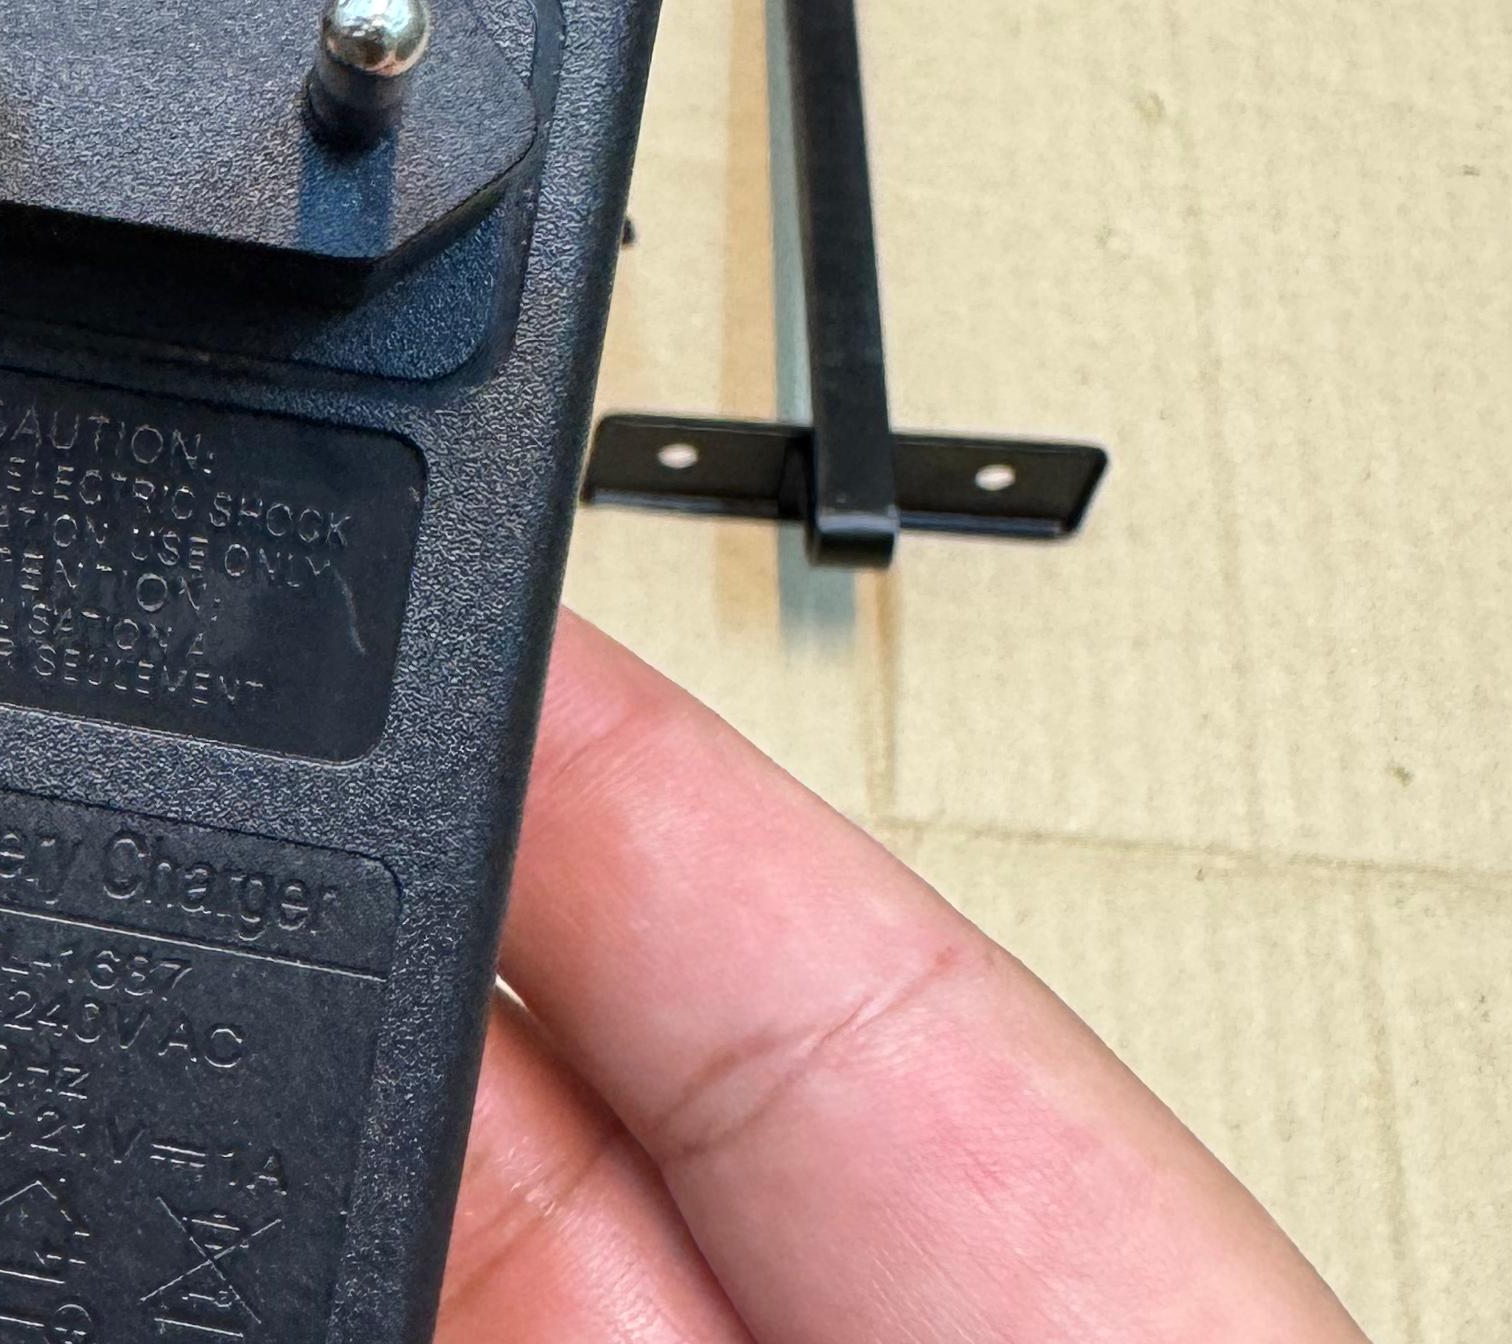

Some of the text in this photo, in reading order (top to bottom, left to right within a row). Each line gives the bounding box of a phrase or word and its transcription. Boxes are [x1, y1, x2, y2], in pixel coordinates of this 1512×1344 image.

[3, 454, 199, 523] ELECTRIC
[205, 490, 354, 549] SHOCK
[127, 526, 210, 572] USE
[220, 542, 334, 594] ONLY
[94, 825, 344, 956] Charger
